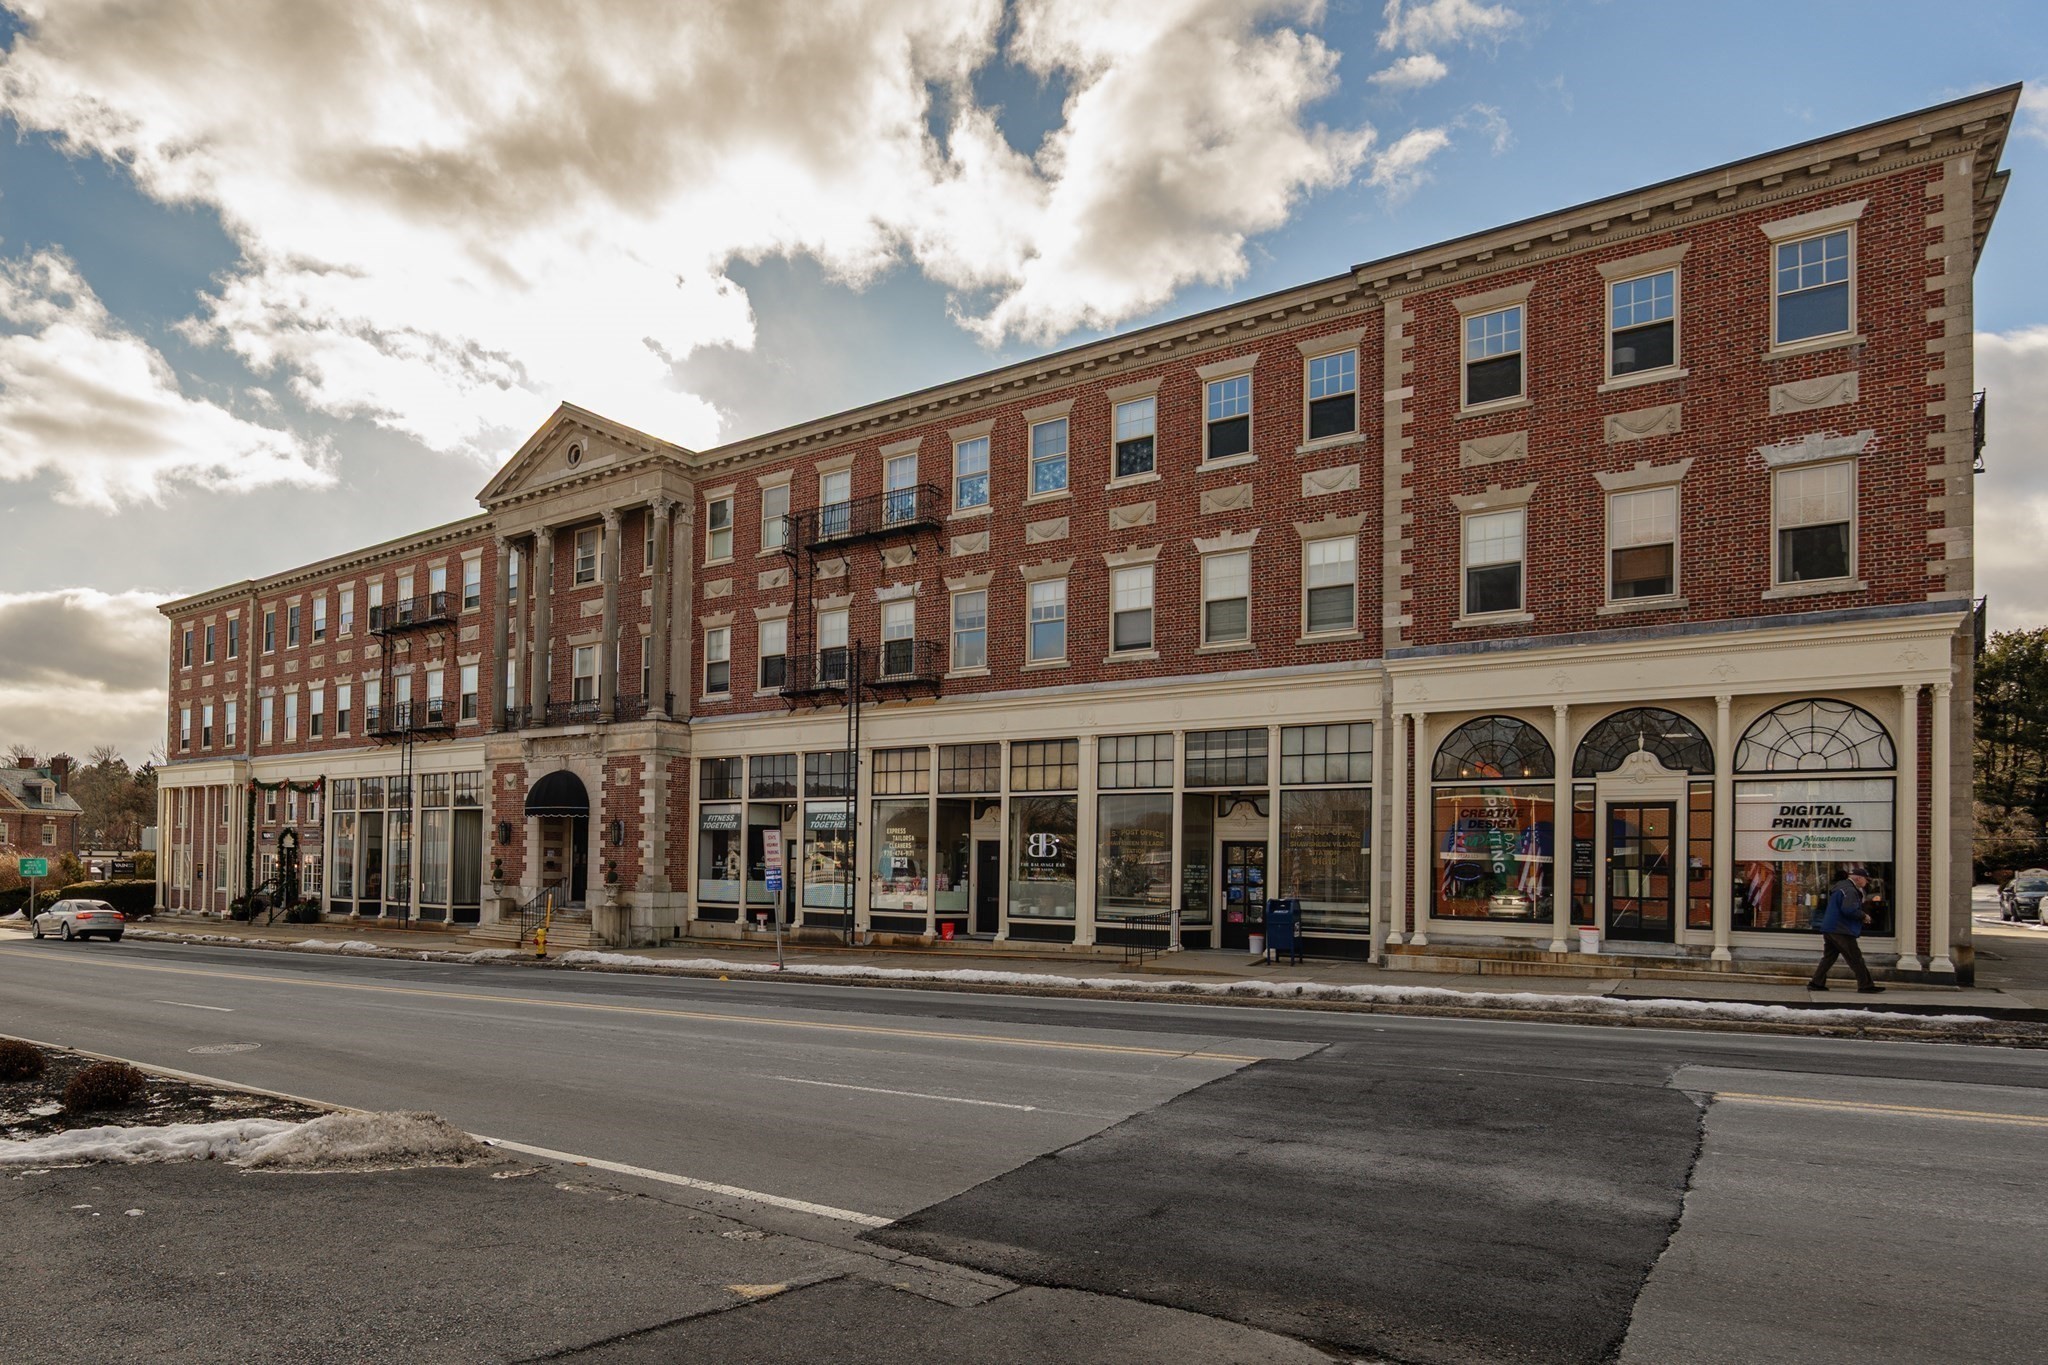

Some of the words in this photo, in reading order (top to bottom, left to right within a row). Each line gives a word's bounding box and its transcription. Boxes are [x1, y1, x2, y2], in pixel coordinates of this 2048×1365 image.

[1460, 809, 1524, 818] CREATIVE
[1779, 805, 1845, 816] DIGITAL
[815, 813, 846, 821] FITNESS
[1468, 819, 1517, 829] DESIGN
[1771, 817, 1853, 828] PRINTING
[1140, 829, 1165, 839] OFFICE
[1333, 830, 1361, 838] OFFICE
